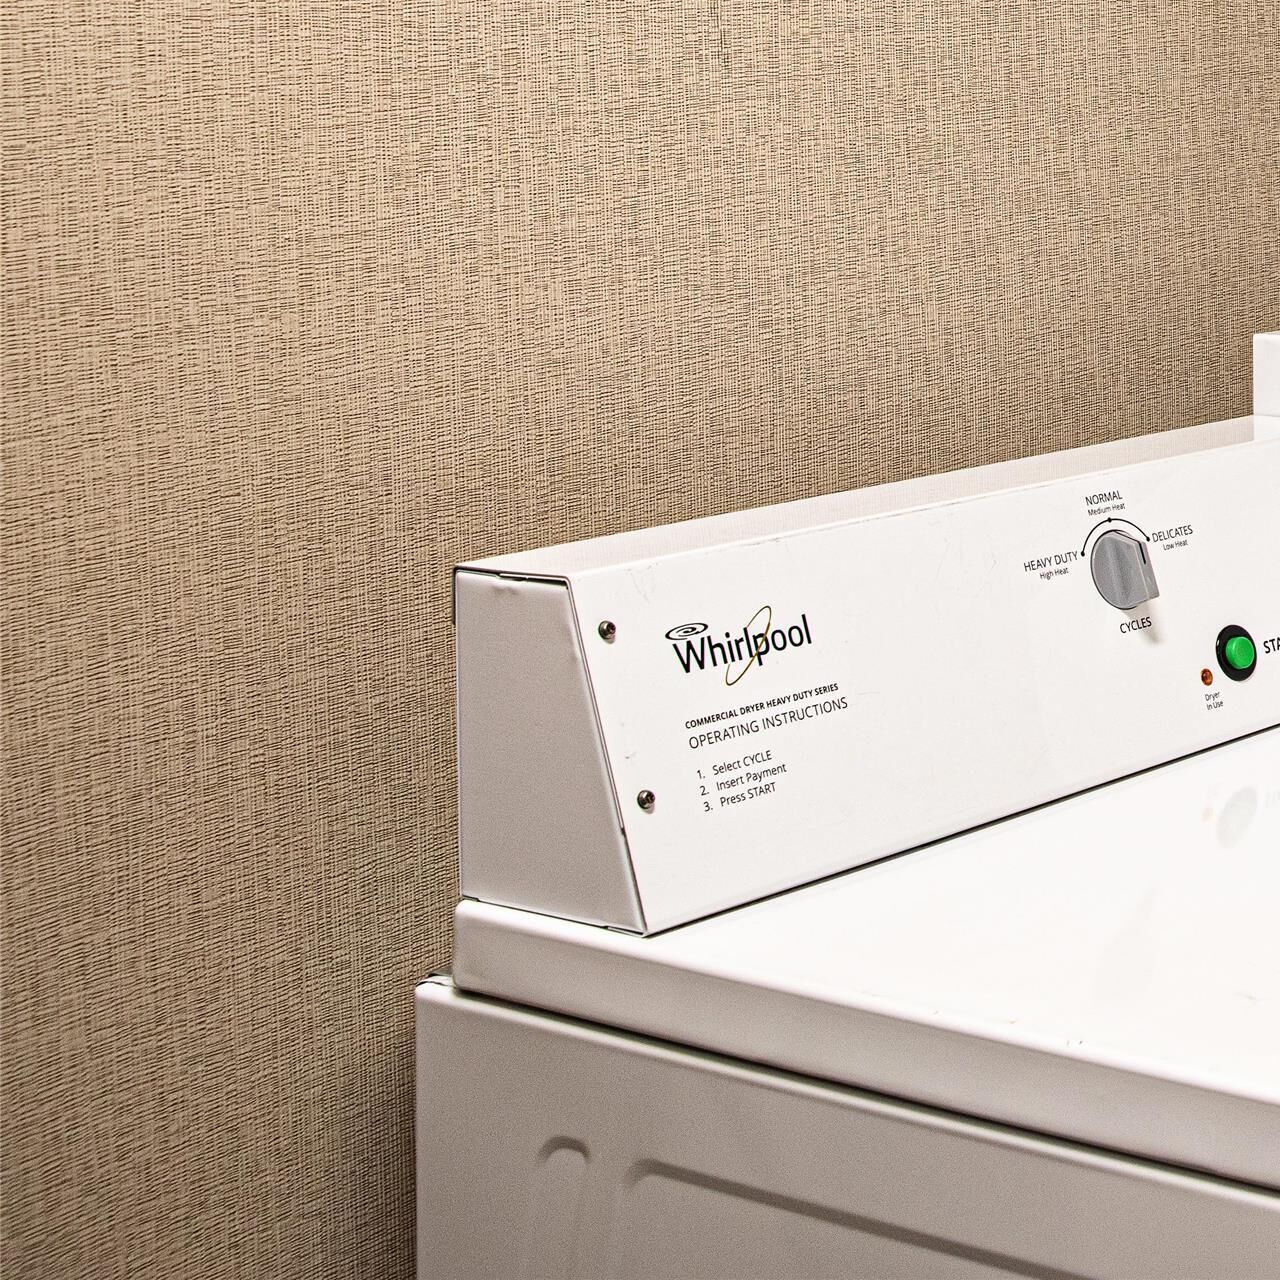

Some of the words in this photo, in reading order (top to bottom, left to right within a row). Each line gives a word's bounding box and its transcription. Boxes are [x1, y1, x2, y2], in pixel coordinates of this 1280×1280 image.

[1085, 490, 1123, 506] NORMAL
[1087, 505, 1110, 517] Medium
[1111, 502, 1125, 511] Heat
[1152, 524, 1193, 543] DELICATES
[1163, 541, 1174, 551] Low
[1175, 539, 1188, 549] Heat
[1023, 556, 1052, 572] HEAVY
[1054, 550, 1078, 565] DUTY
[1040, 570, 1053, 580] High
[1054, 567, 1069, 577] Heat
[1119, 616, 1152, 634] CYCLES
[672, 613, 812, 674] Whirlpool
[1204, 690, 1220, 702] Dryer
[685, 709, 739, 730] COMMERCIAL
[739, 702, 766, 716] DRYER
[766, 695, 791, 709] HEAVY
[792, 689, 813, 702] DUTY
[814, 683, 839, 696] SERIES
[688, 720, 760, 749] OPERATING
[762, 696, 849, 730] INSTRUCTIONS
[696, 769, 706, 780] 1.
[712, 759, 742, 776] Select
[742, 750, 773, 767] CYCLE
[700, 785, 710, 796] 2.
[716, 776, 744, 792] Insert
[746, 763, 787, 783] Payment
[703, 801, 713, 812] 3.
[719, 793, 746, 807] Press
[748, 782, 776, 800] START
